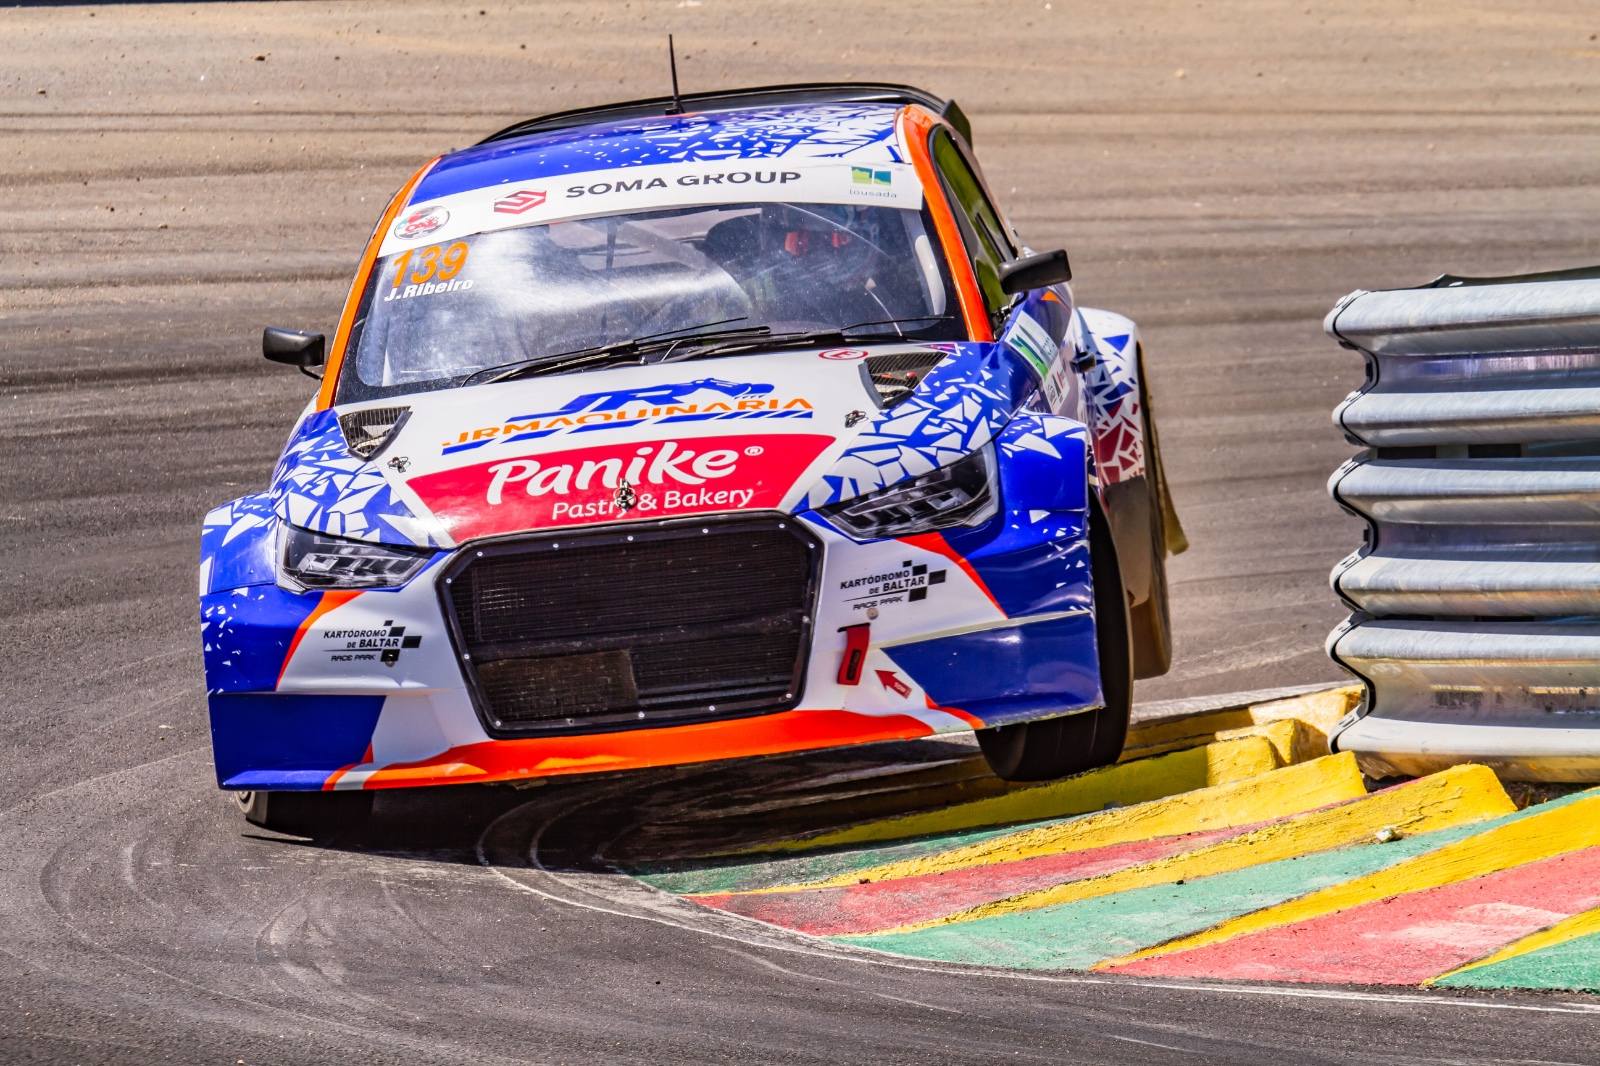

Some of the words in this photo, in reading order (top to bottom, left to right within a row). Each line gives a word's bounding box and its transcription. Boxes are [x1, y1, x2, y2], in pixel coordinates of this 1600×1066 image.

[566, 178, 669, 198] SOMA
[677, 170, 801, 187] GROUP
[391, 241, 470, 288] 139
[384, 278, 474, 301] J.Ribeiro
[487, 441, 737, 505] Panike
[637, 493, 657, 511] &
[663, 488, 754, 509] Bakery
[869, 587, 879, 595] DE
[883, 576, 925, 591] BALTAR
[853, 601, 878, 610] RACE
[880, 596, 903, 605] PARK
[347, 641, 357, 649] DE
[359, 638, 399, 648] BALTAR
